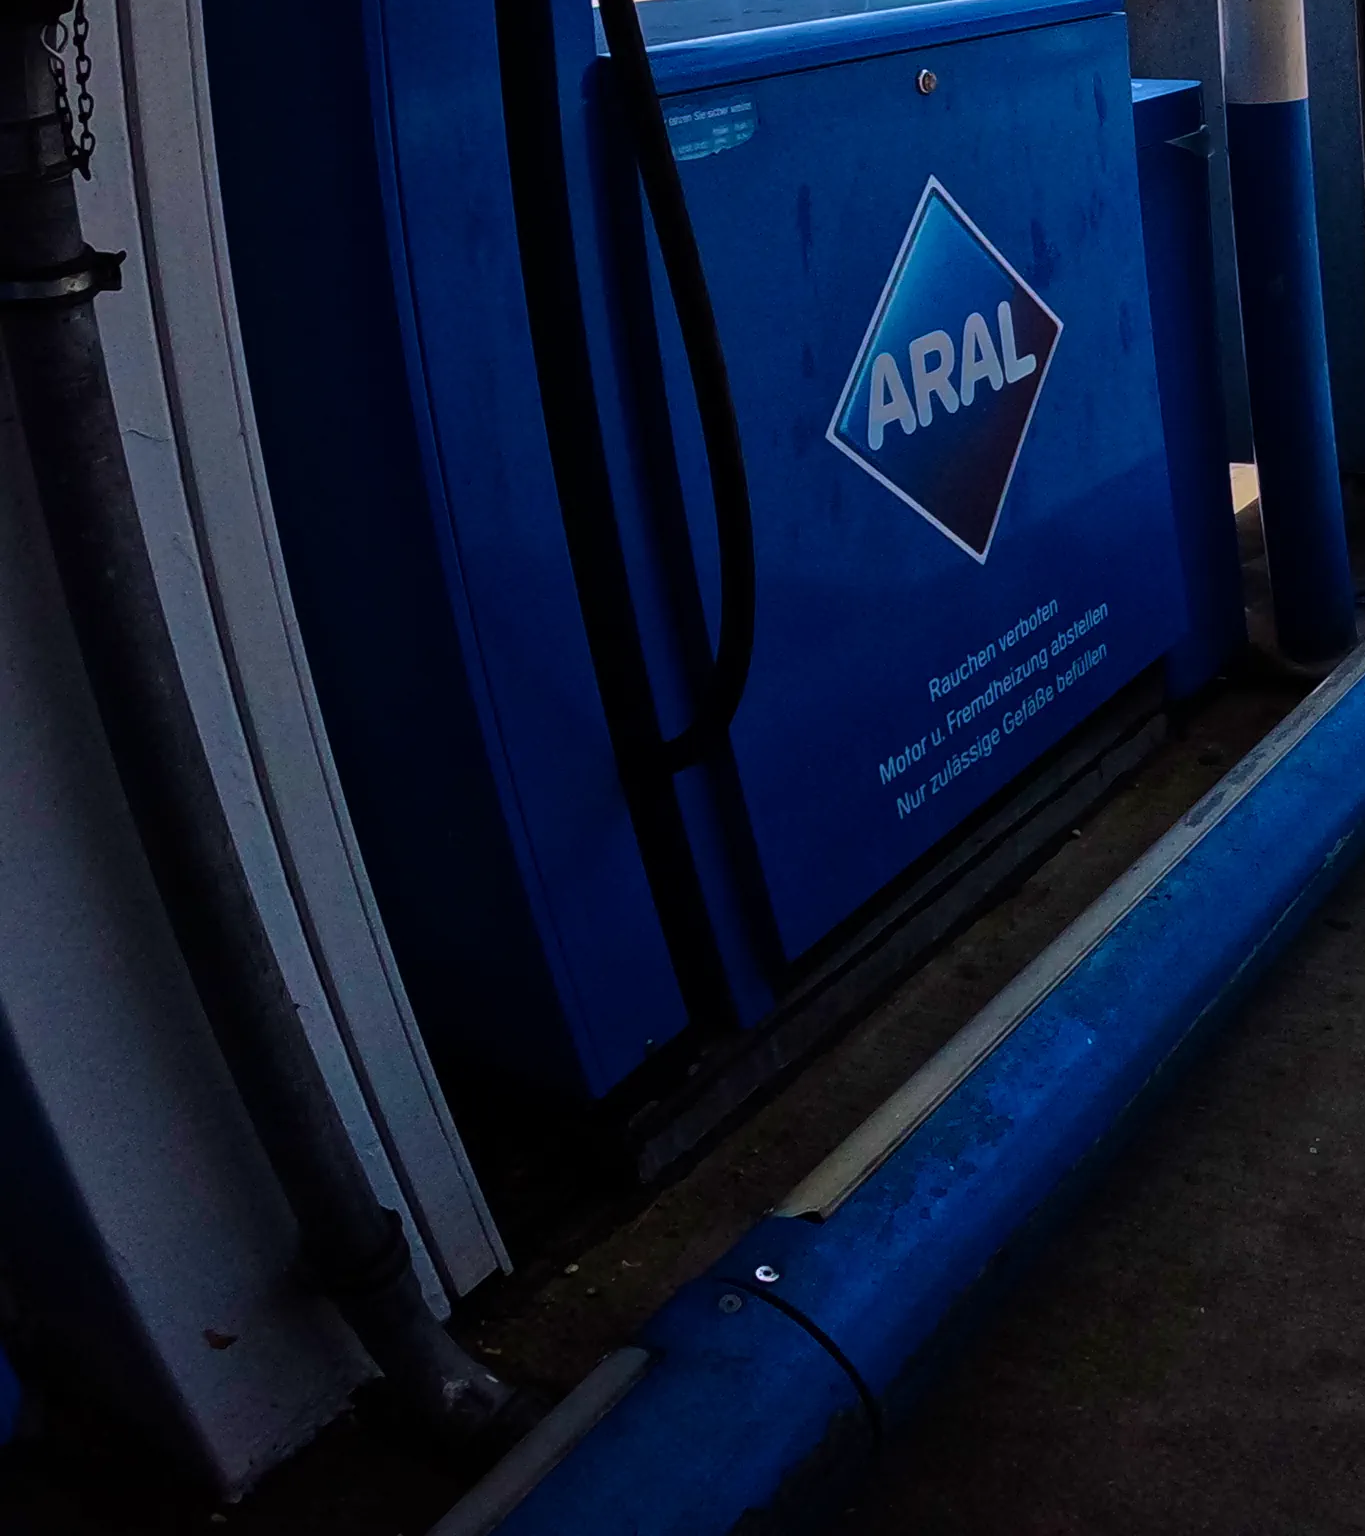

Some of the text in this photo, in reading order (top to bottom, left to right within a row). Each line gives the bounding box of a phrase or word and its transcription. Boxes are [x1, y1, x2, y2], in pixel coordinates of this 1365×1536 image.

[867, 301, 1037, 451] ARAL
[879, 602, 1108, 785] Motor u. Fremdheizung abstellen
[896, 643, 1107, 820] Nur zulässige Gefäße befüllen
[928, 599, 1058, 703] Rauchen verboten
